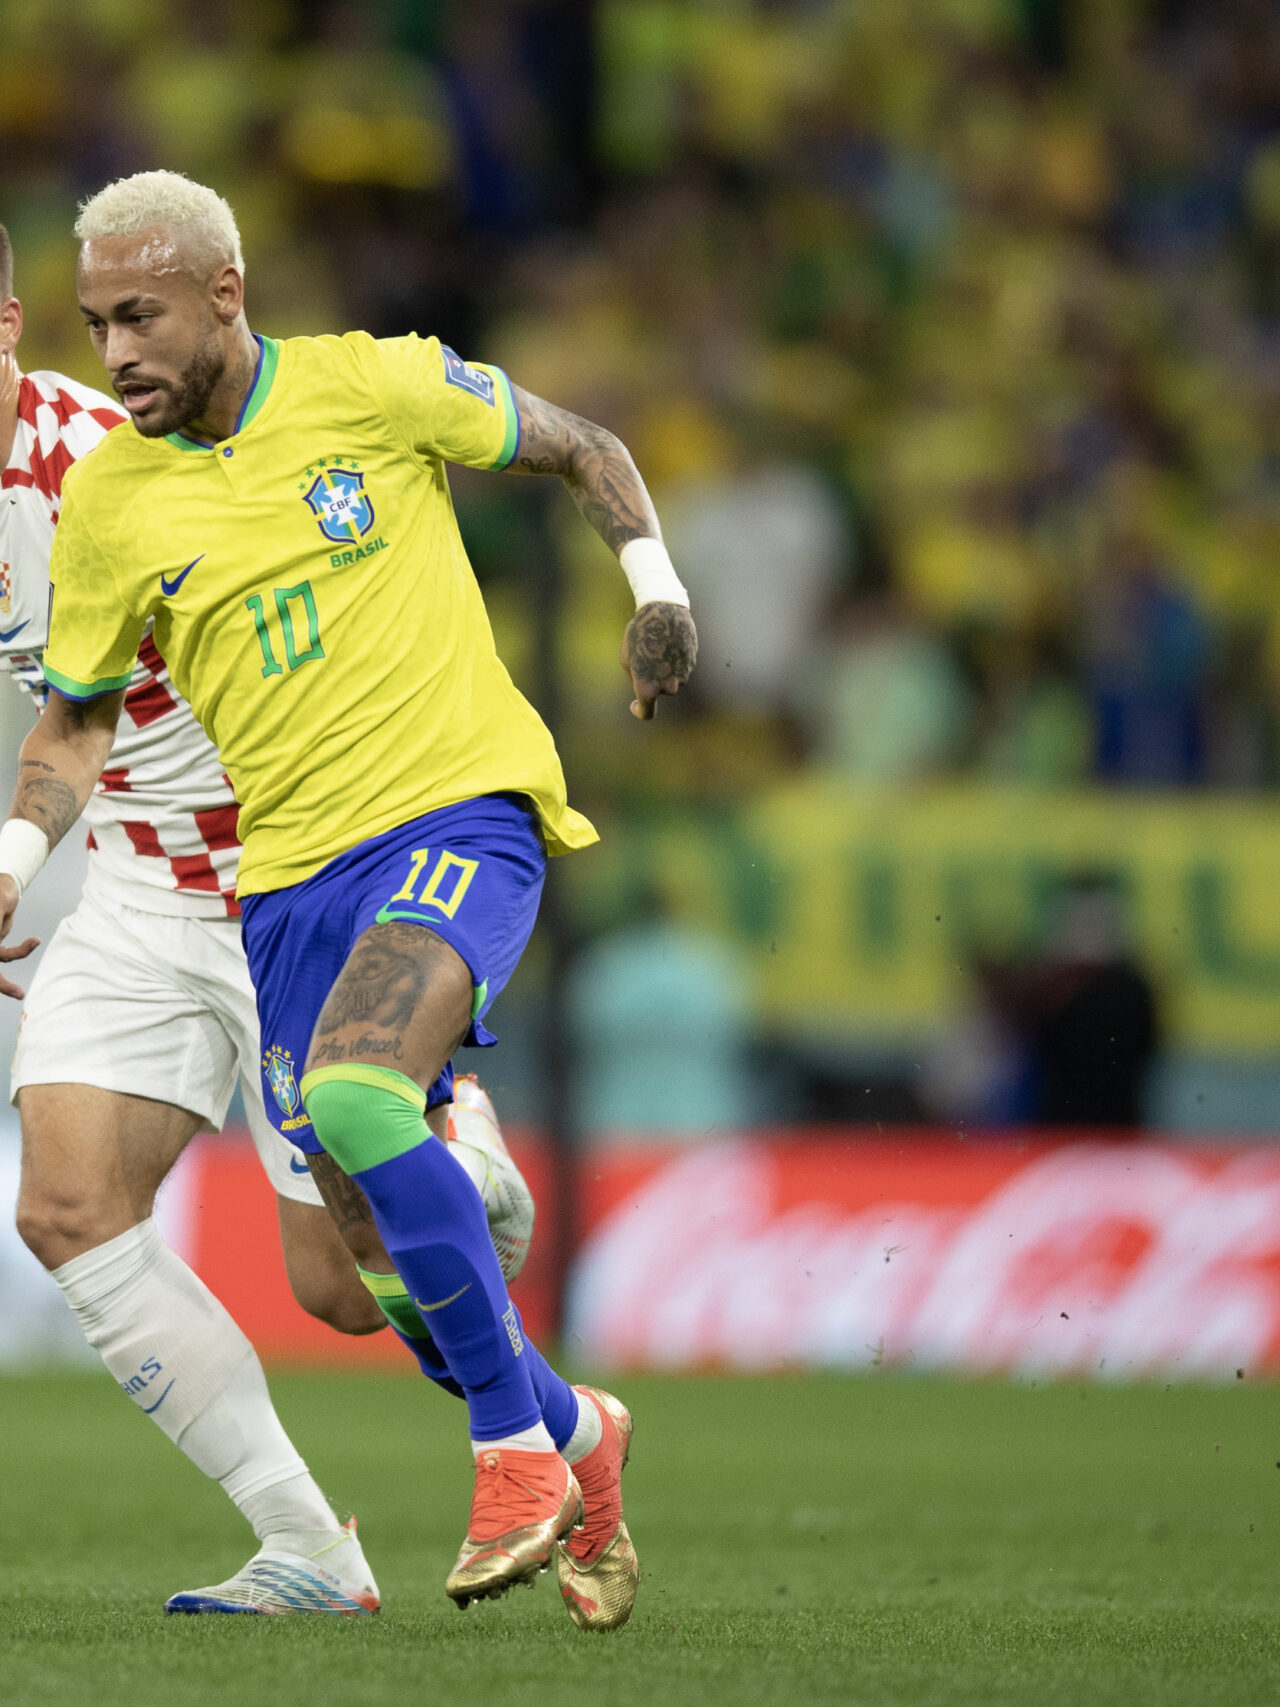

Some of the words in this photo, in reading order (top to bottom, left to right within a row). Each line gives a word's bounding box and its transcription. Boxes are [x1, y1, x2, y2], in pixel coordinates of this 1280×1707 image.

[329, 496, 352, 513] CBF
[329, 536, 390, 568] BRASIL
[245, 579, 326, 679] 10
[389, 847, 480, 921] 10
[501, 1301, 524, 1357] BRASIL
